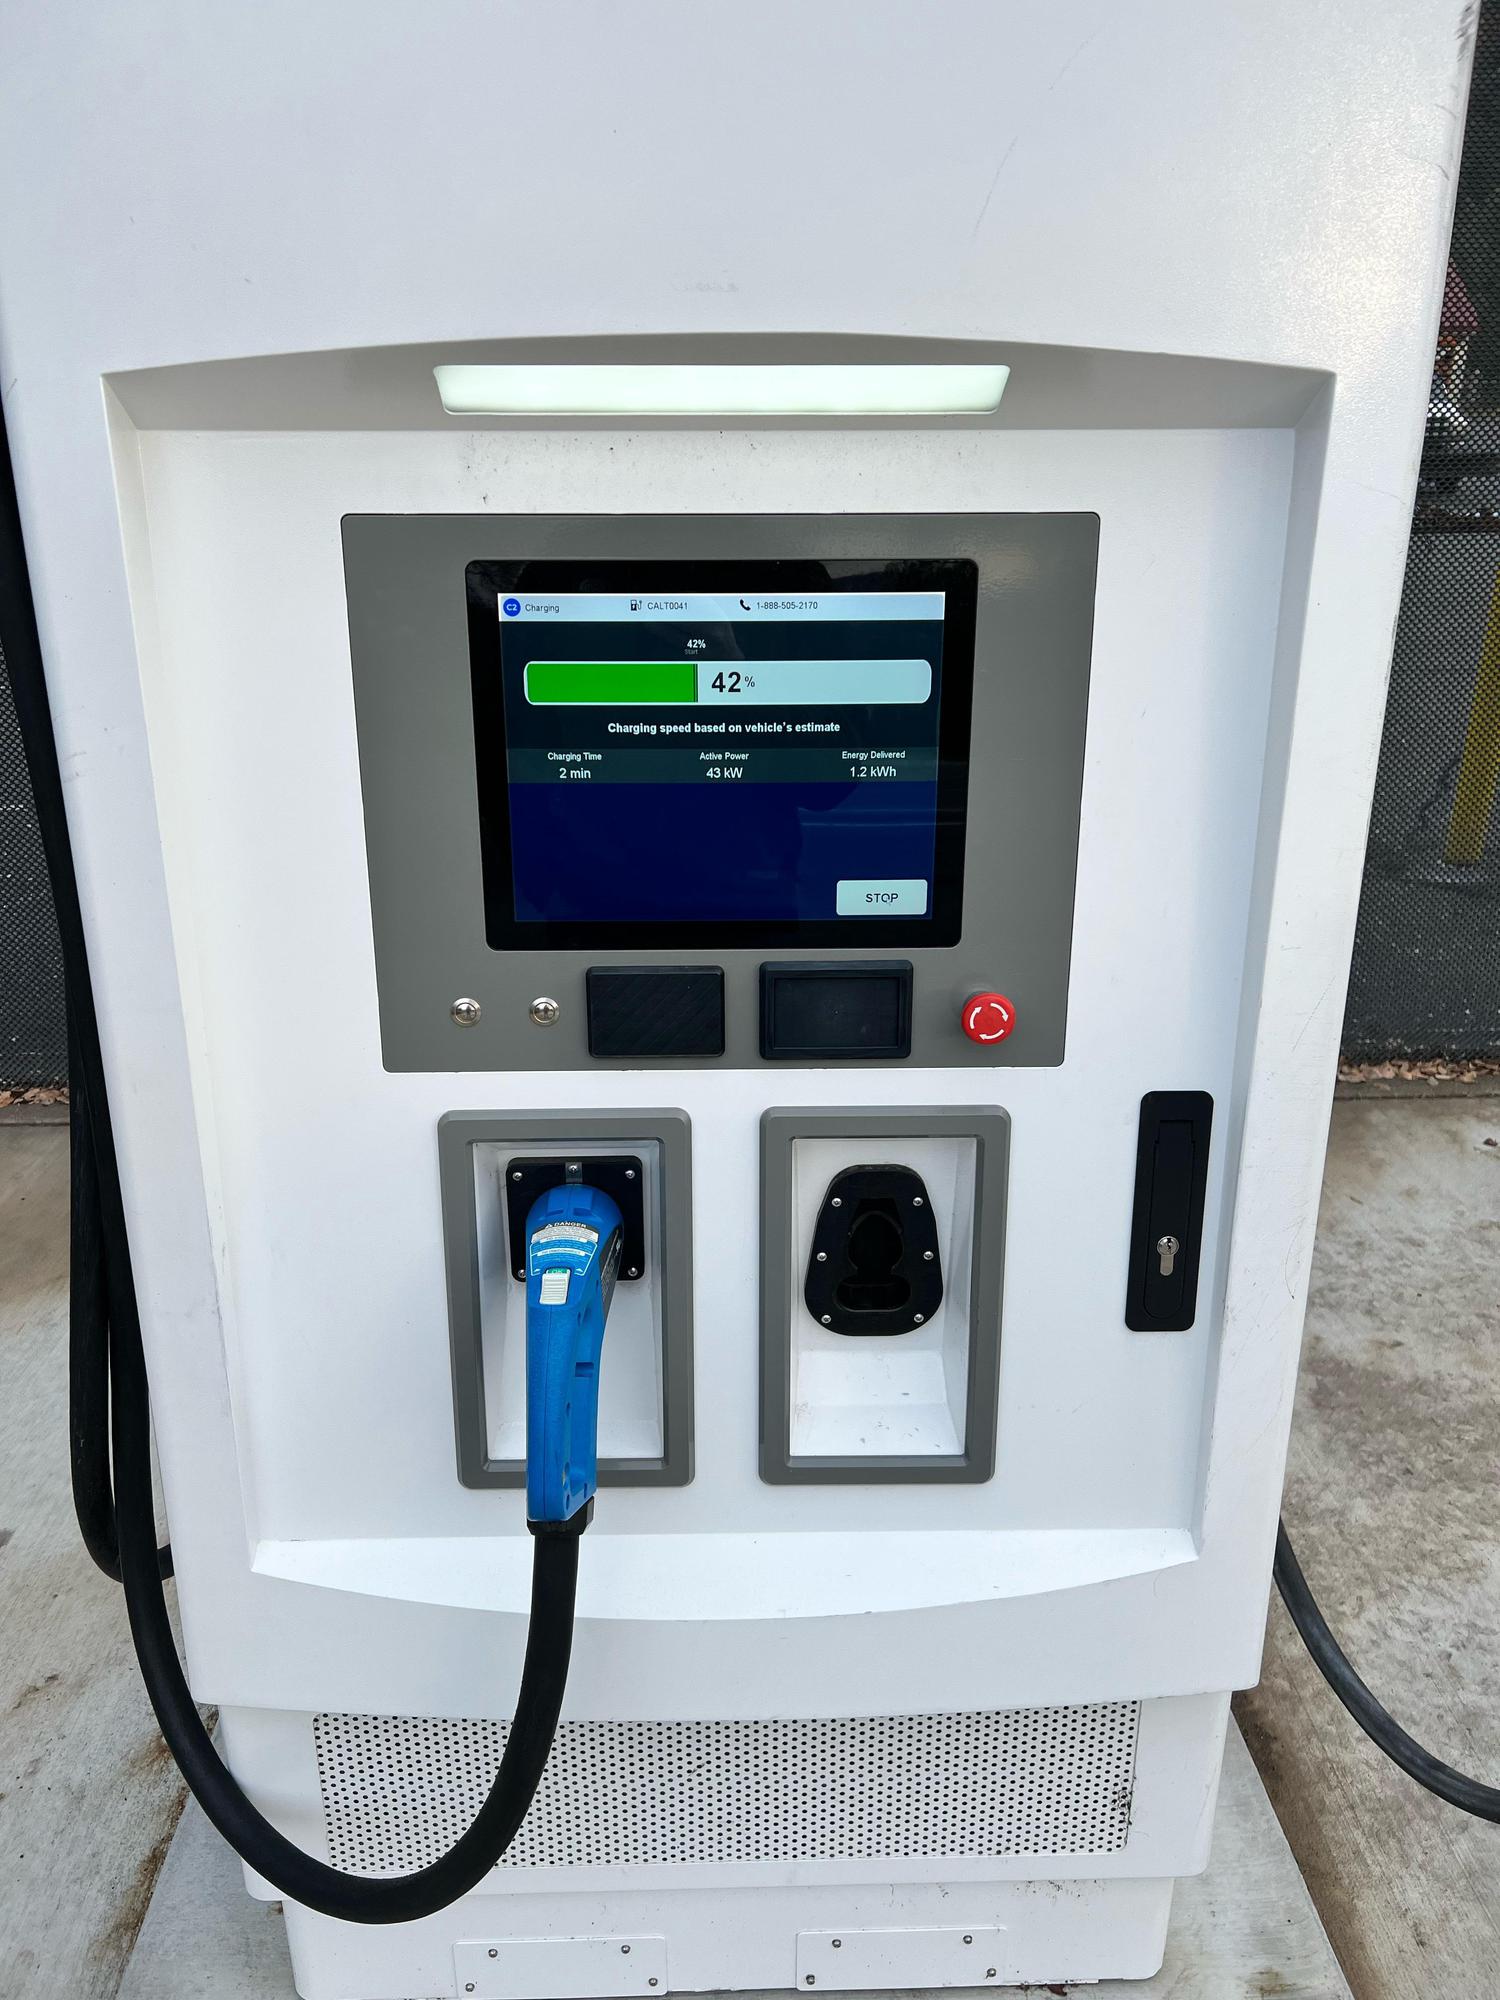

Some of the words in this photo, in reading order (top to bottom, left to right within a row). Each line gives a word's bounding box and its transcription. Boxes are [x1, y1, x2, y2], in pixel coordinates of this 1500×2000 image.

[506, 602, 518, 612] C2
[525, 602, 560, 614] Charging
[647, 602, 688, 610] CALT0041
[756, 602, 818, 610] 1-888-505-2170
[686, 639, 706, 649] 42%
[607, 723, 657, 735] Charging
[659, 723, 691, 735] speed
[694, 723, 726, 733] based
[728, 725, 742, 733] on
[795, 722, 841, 732] estimate
[547, 752, 582, 762] Charging
[583, 752, 602, 761] Time
[699, 752, 722, 761] Active
[724, 752, 750, 761] Power
[841, 751, 868, 761] Energy
[870, 750, 906, 760] Delivered
[559, 768, 567, 779] 2
[570, 768, 592, 779] min
[706, 767, 721, 779] 43
[723, 767, 743, 779] kW
[850, 767, 867, 777] 1.2
[870, 766, 897, 777] kWh
[865, 893, 899, 903] STOP
